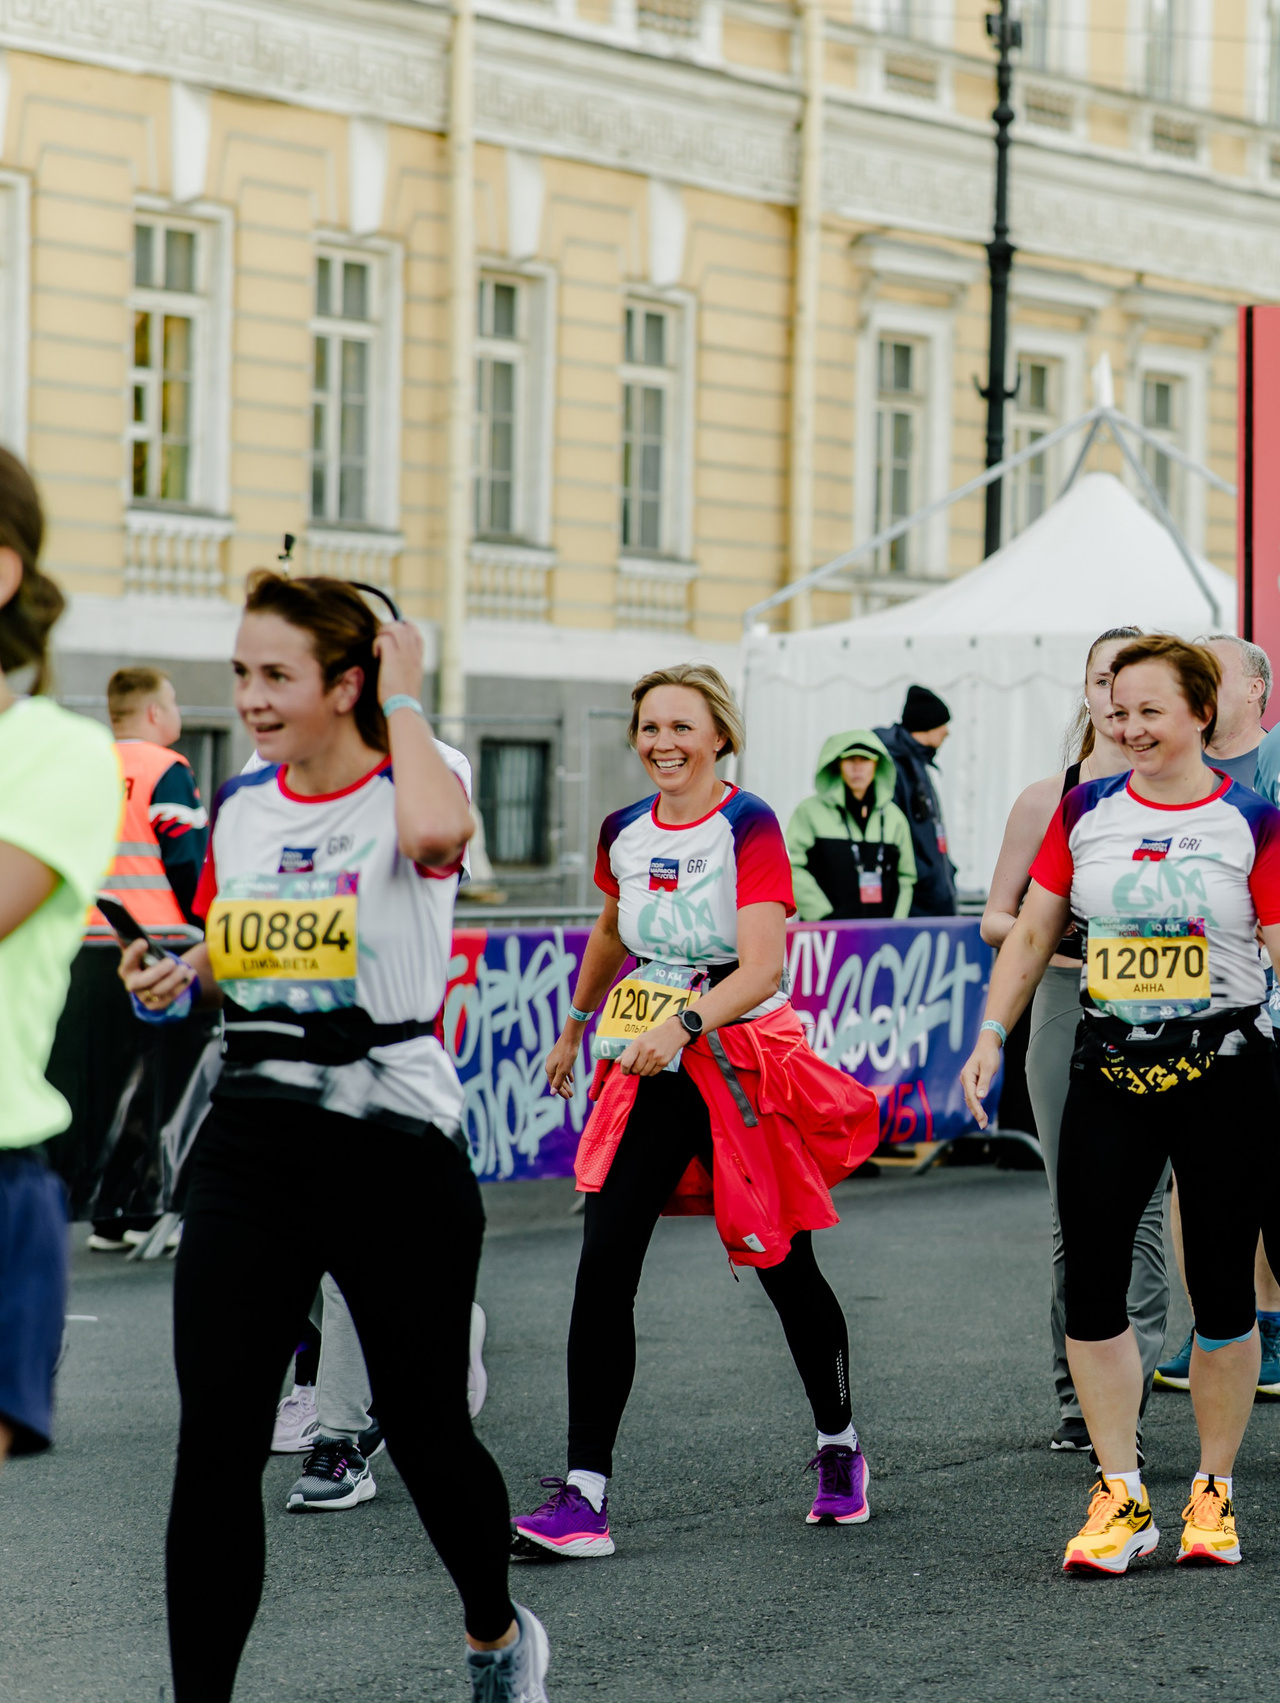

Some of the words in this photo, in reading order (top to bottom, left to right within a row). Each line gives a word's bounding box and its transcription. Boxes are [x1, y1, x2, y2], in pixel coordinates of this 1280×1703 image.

[216, 909, 351, 955] 10884
[1151, 924, 1163, 932] 10
[1095, 945, 1204, 980] 12070
[655, 968, 667, 977] 10
[668, 971, 683, 982] КМ
[1133, 983, 1165, 993] АННА
[611, 987, 690, 1022] 12071
